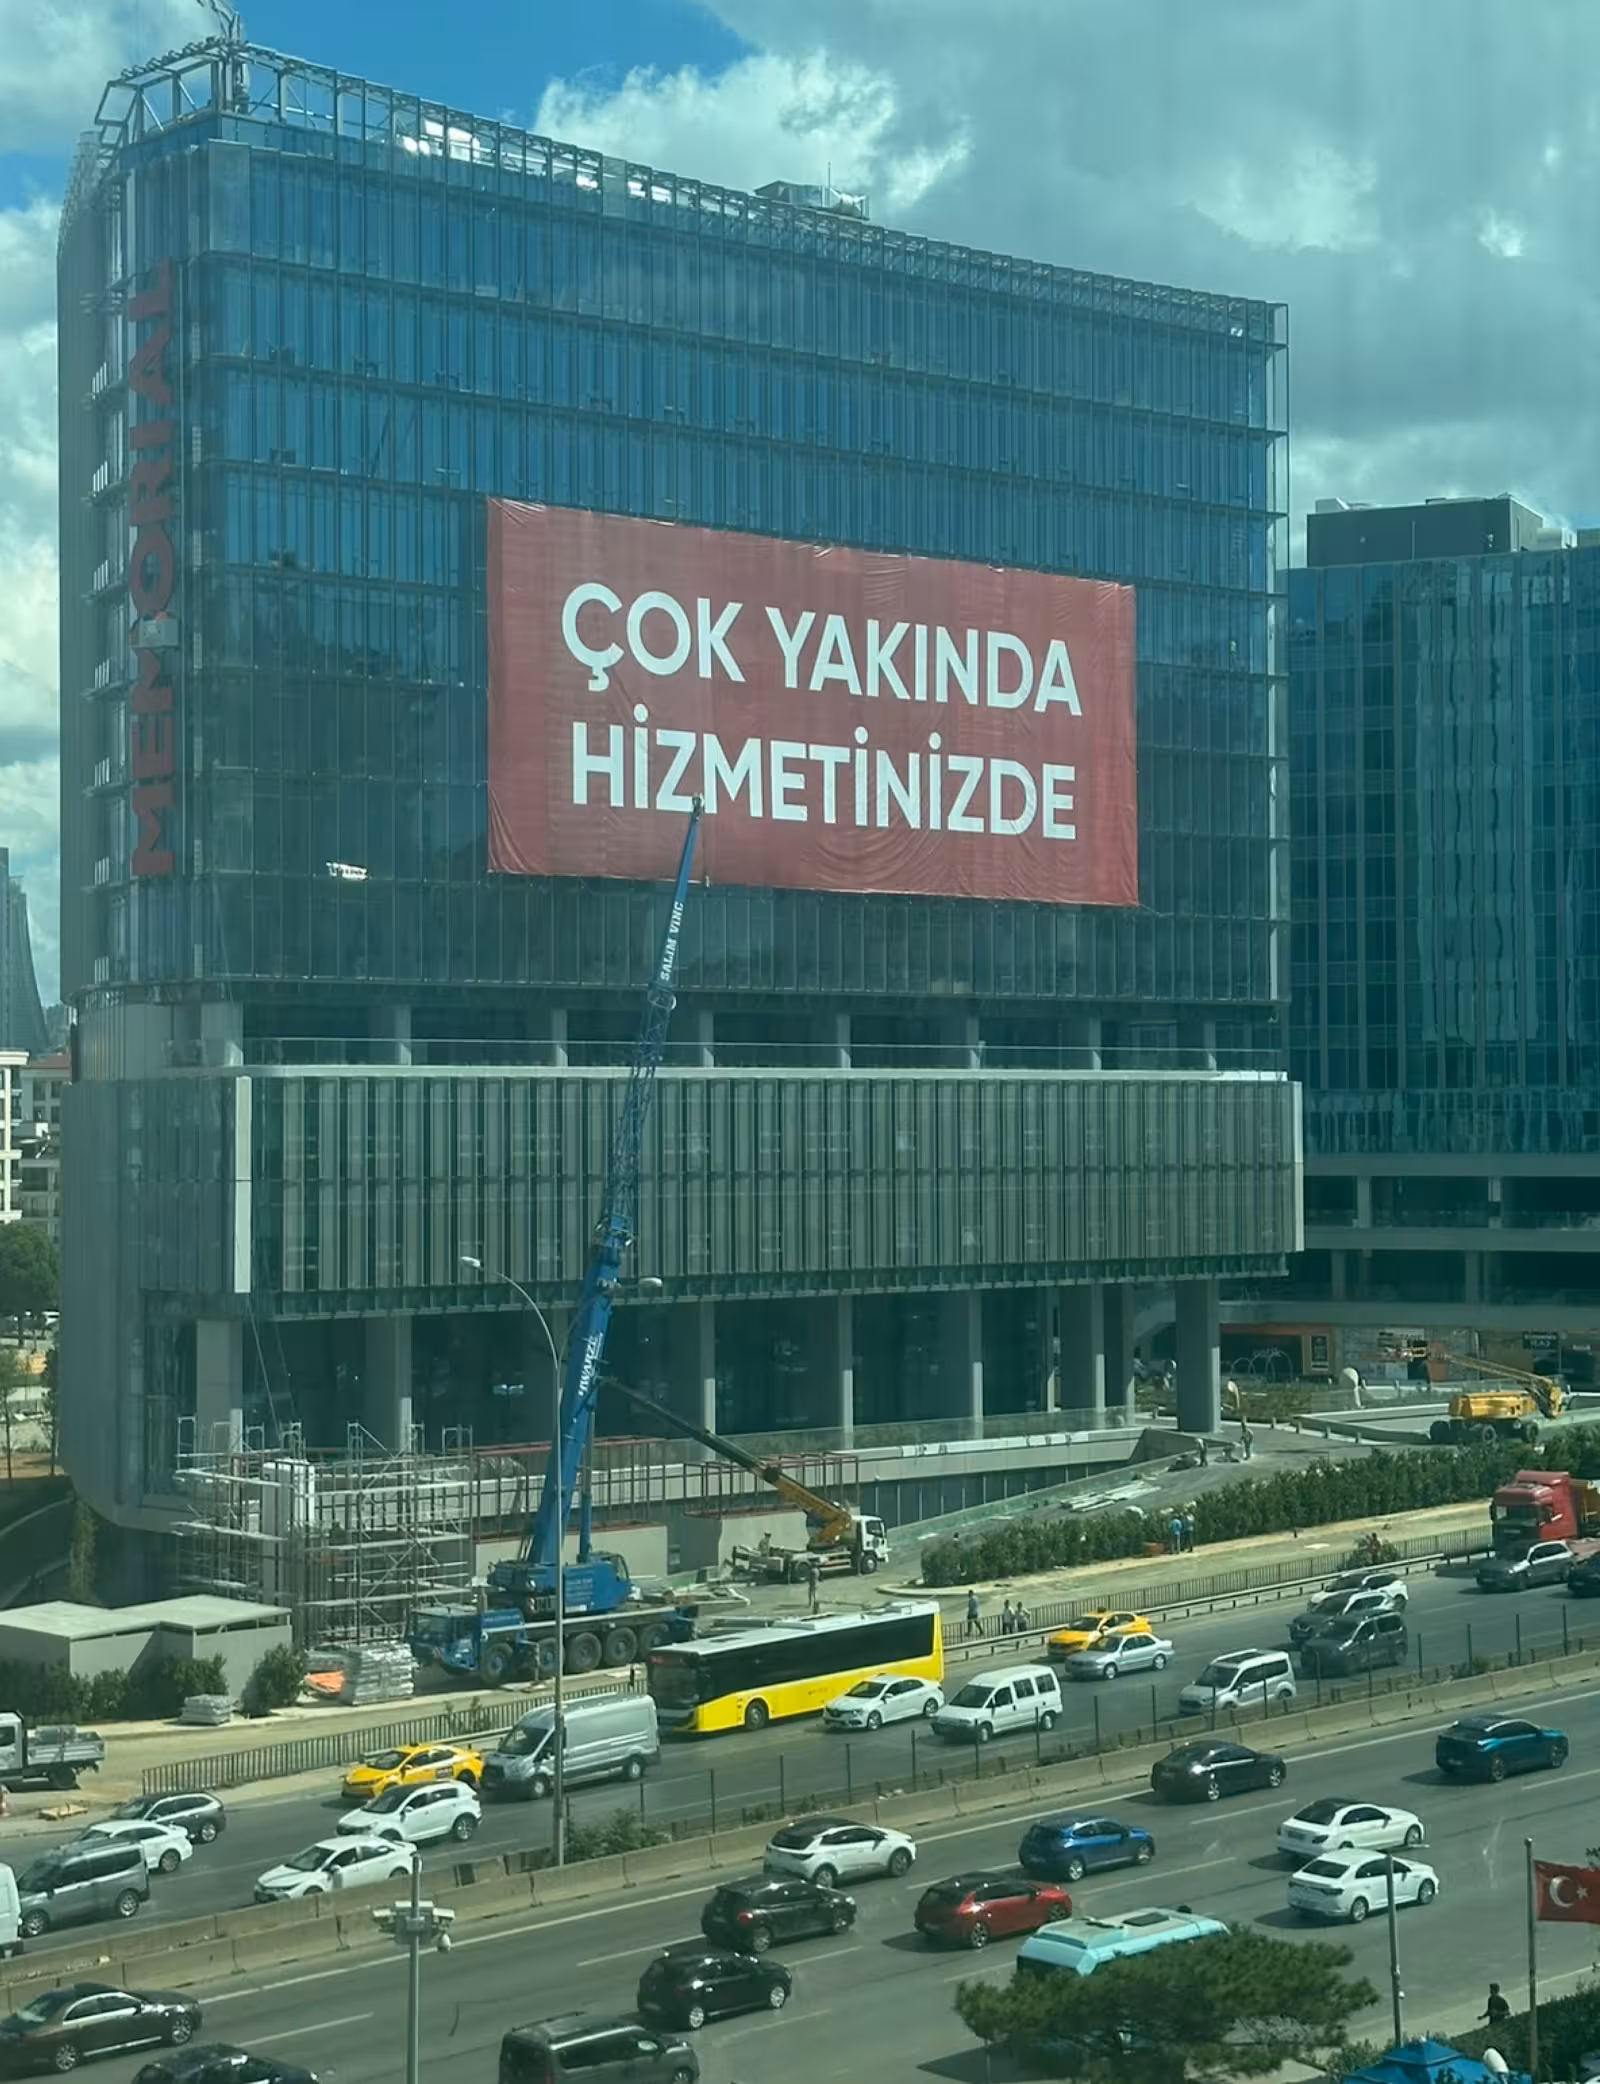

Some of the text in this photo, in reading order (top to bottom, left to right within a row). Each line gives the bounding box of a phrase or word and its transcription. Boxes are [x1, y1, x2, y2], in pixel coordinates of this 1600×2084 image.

[129, 256, 175, 876] MEMORIAL
[561, 582, 1083, 716] ÇOK YAKINDA
[572, 703, 1077, 840] HİZMETİNİZDE
